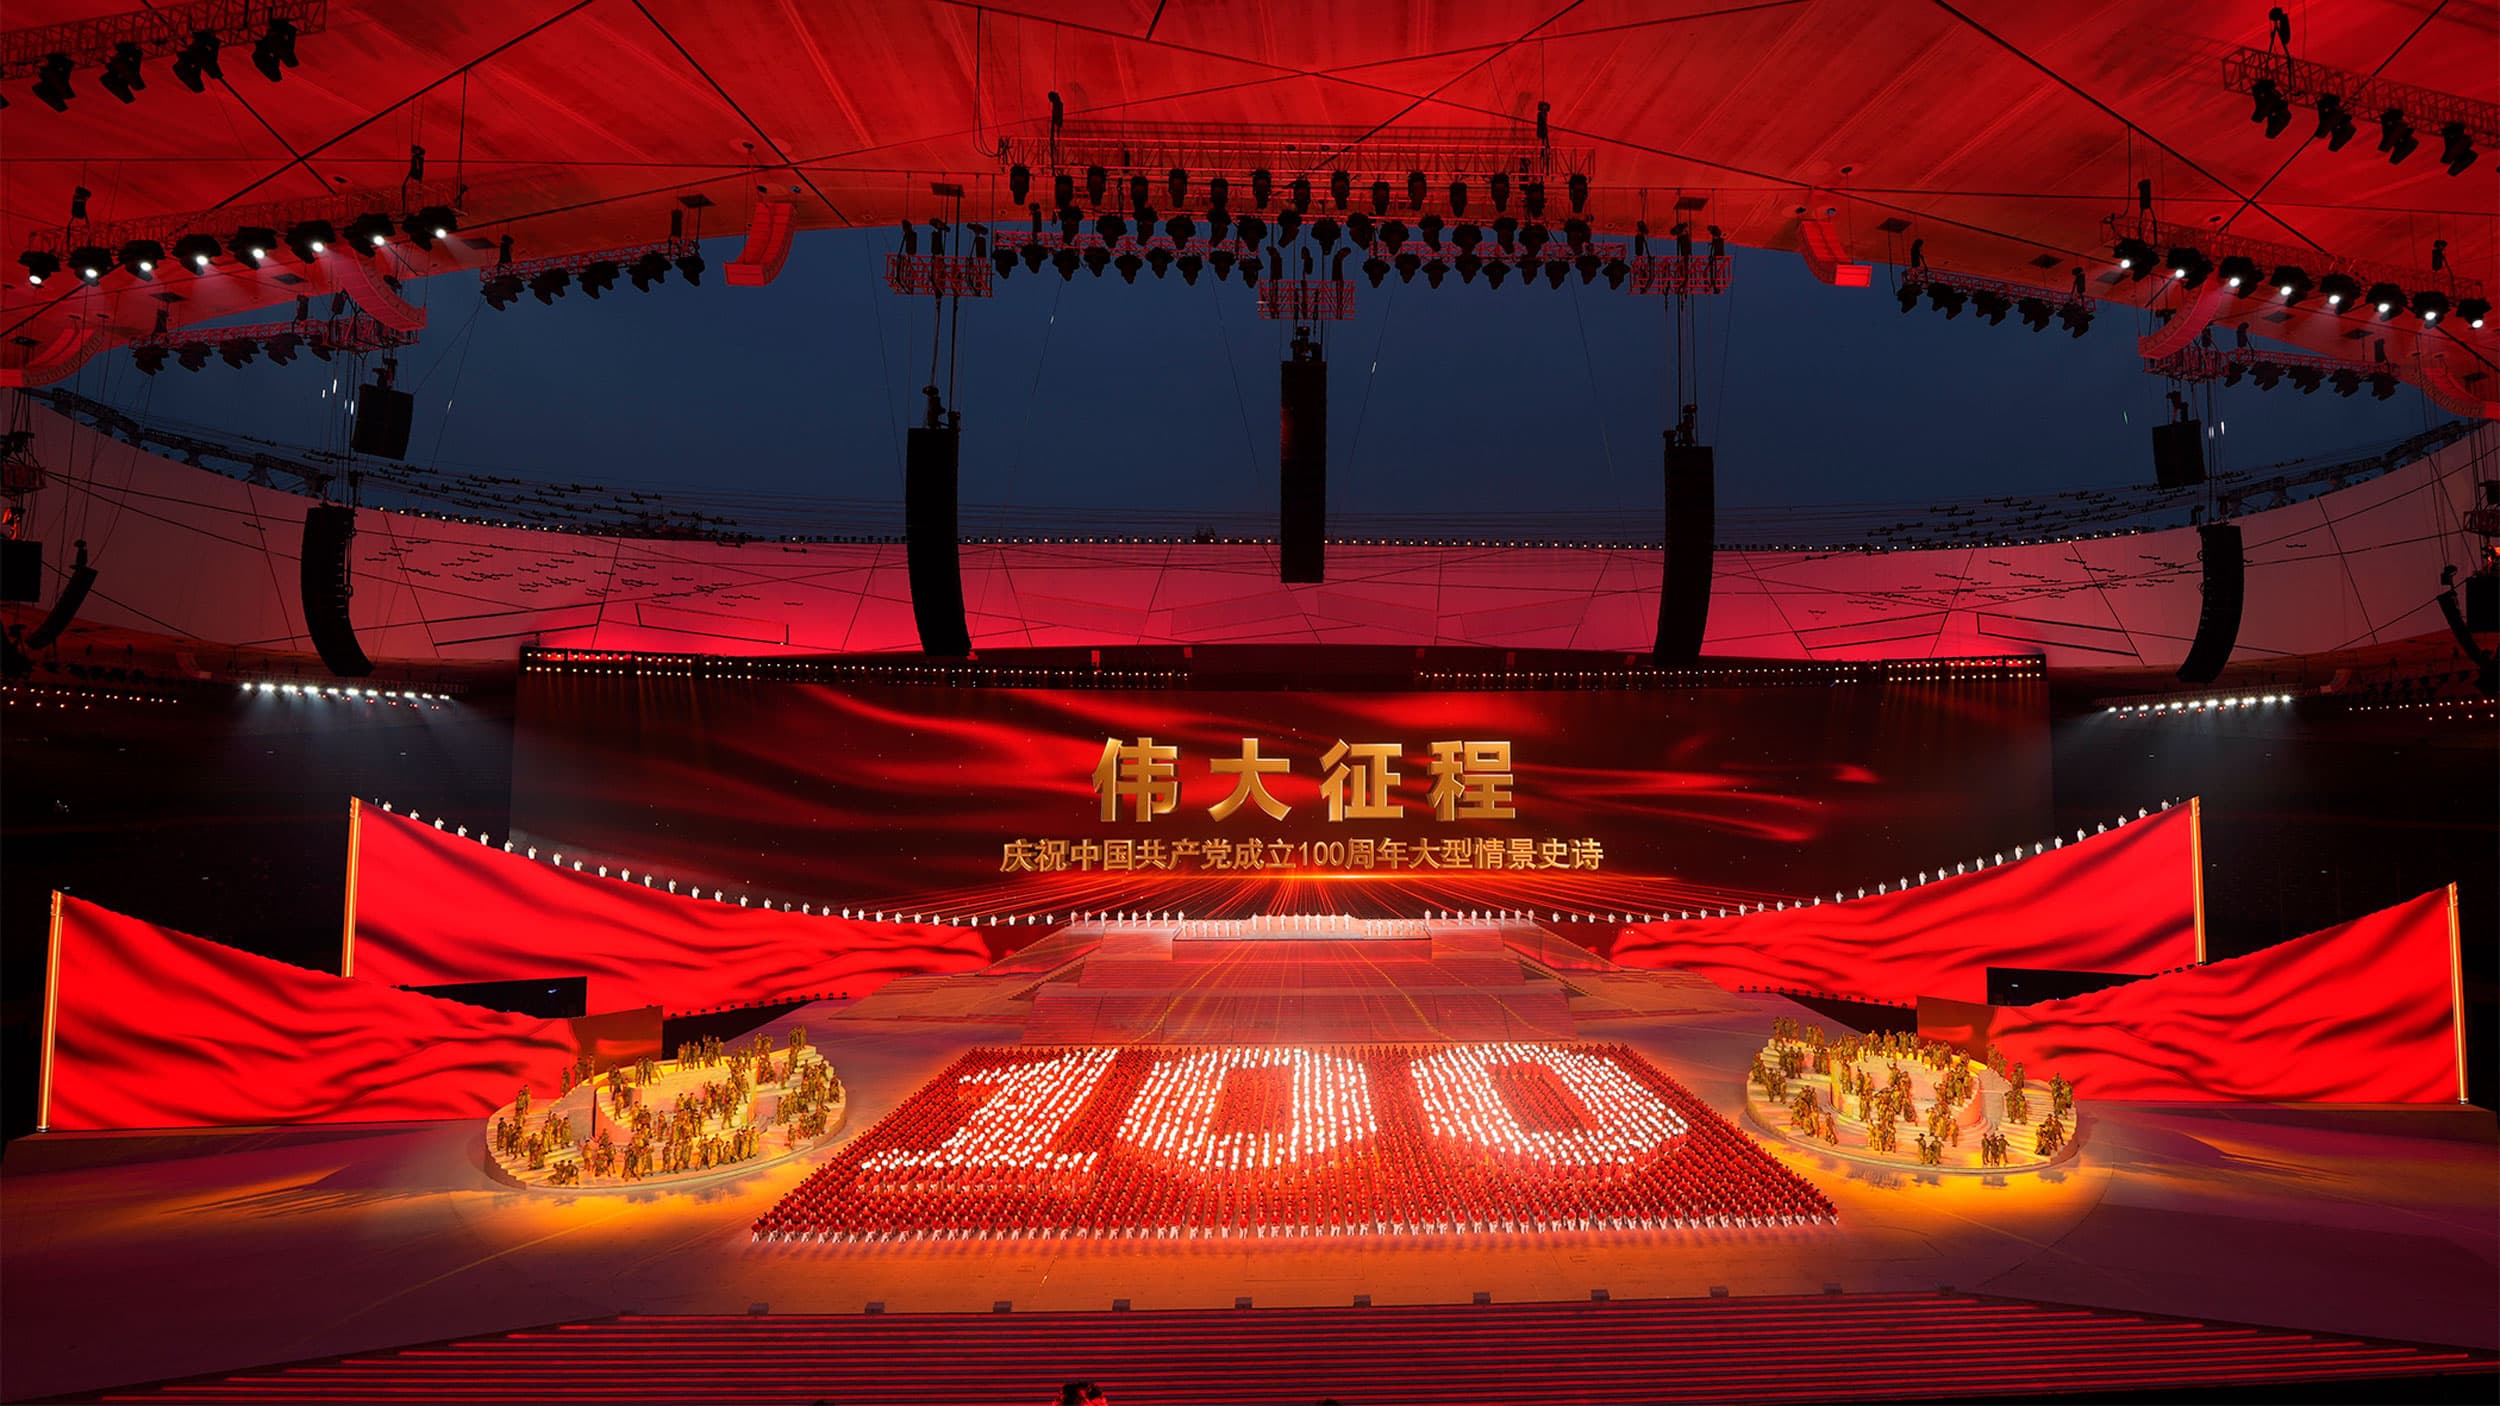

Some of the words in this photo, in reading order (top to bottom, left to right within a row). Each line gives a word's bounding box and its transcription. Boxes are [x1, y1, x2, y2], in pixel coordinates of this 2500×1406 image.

[1093, 737, 1517, 823] 伟大征程
[1000, 838, 1605, 873] 庆祝中国共产党成立100周年大型情景史诗
[860, 1043, 1689, 1172] 100
